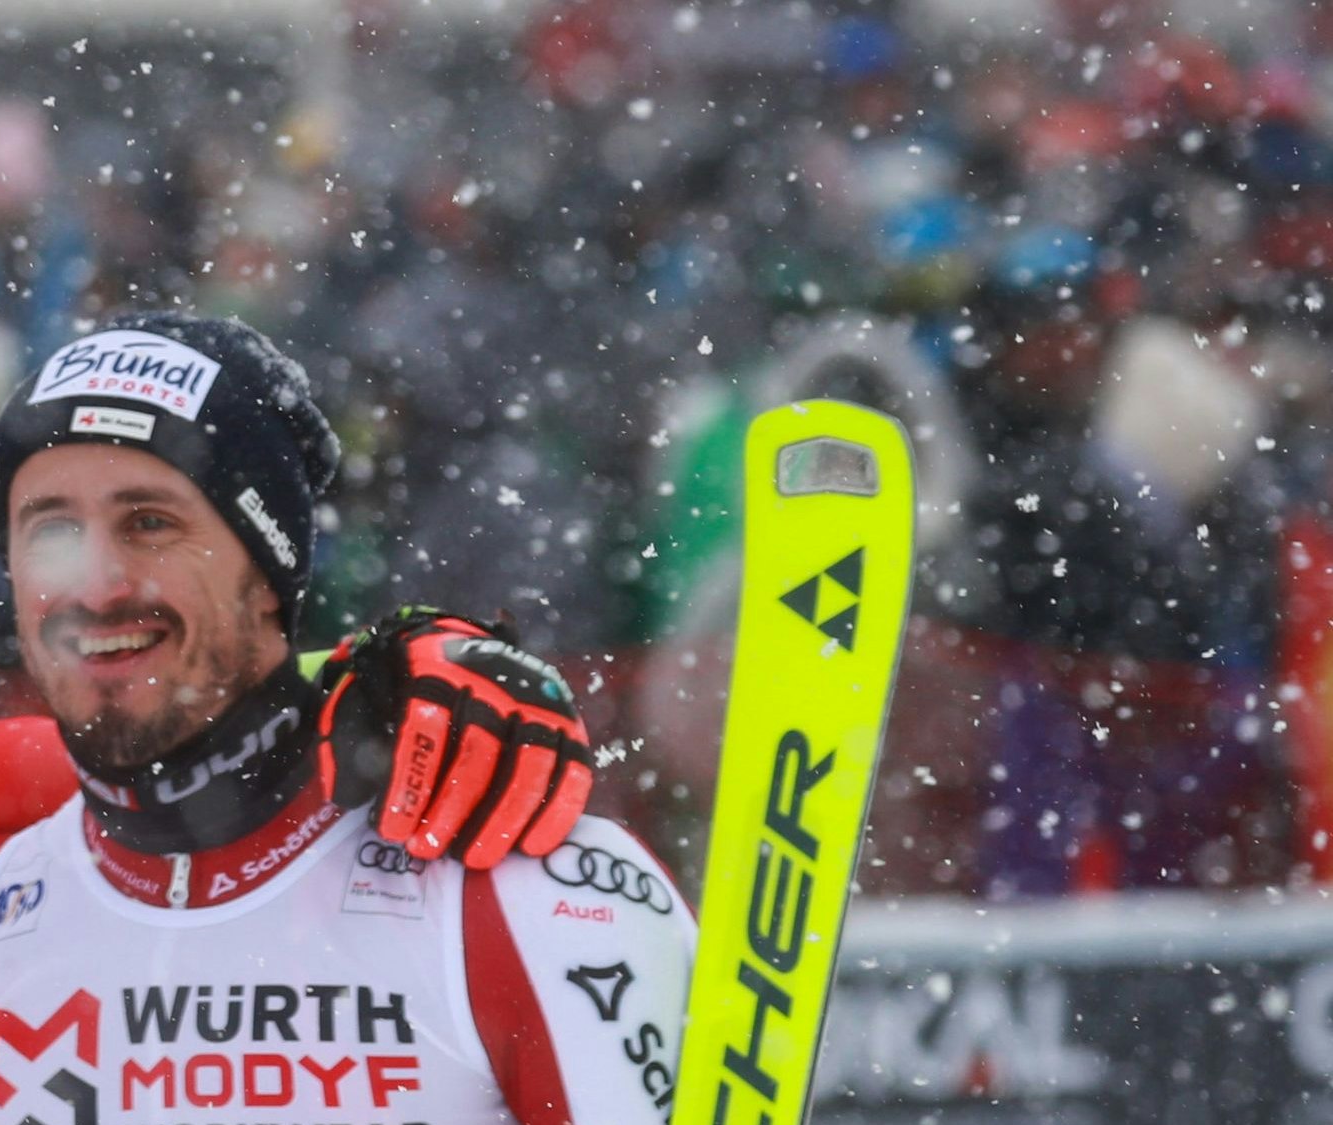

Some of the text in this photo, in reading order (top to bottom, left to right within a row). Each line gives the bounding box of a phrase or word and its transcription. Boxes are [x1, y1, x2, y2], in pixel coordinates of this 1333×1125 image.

[87, 377, 187, 408] SPORTS
[240, 801, 334, 881] Schöffe
[552, 900, 614, 924] Audi
[121, 984, 416, 1045] WÜRTH
[121, 1054, 421, 1111] MODYF
